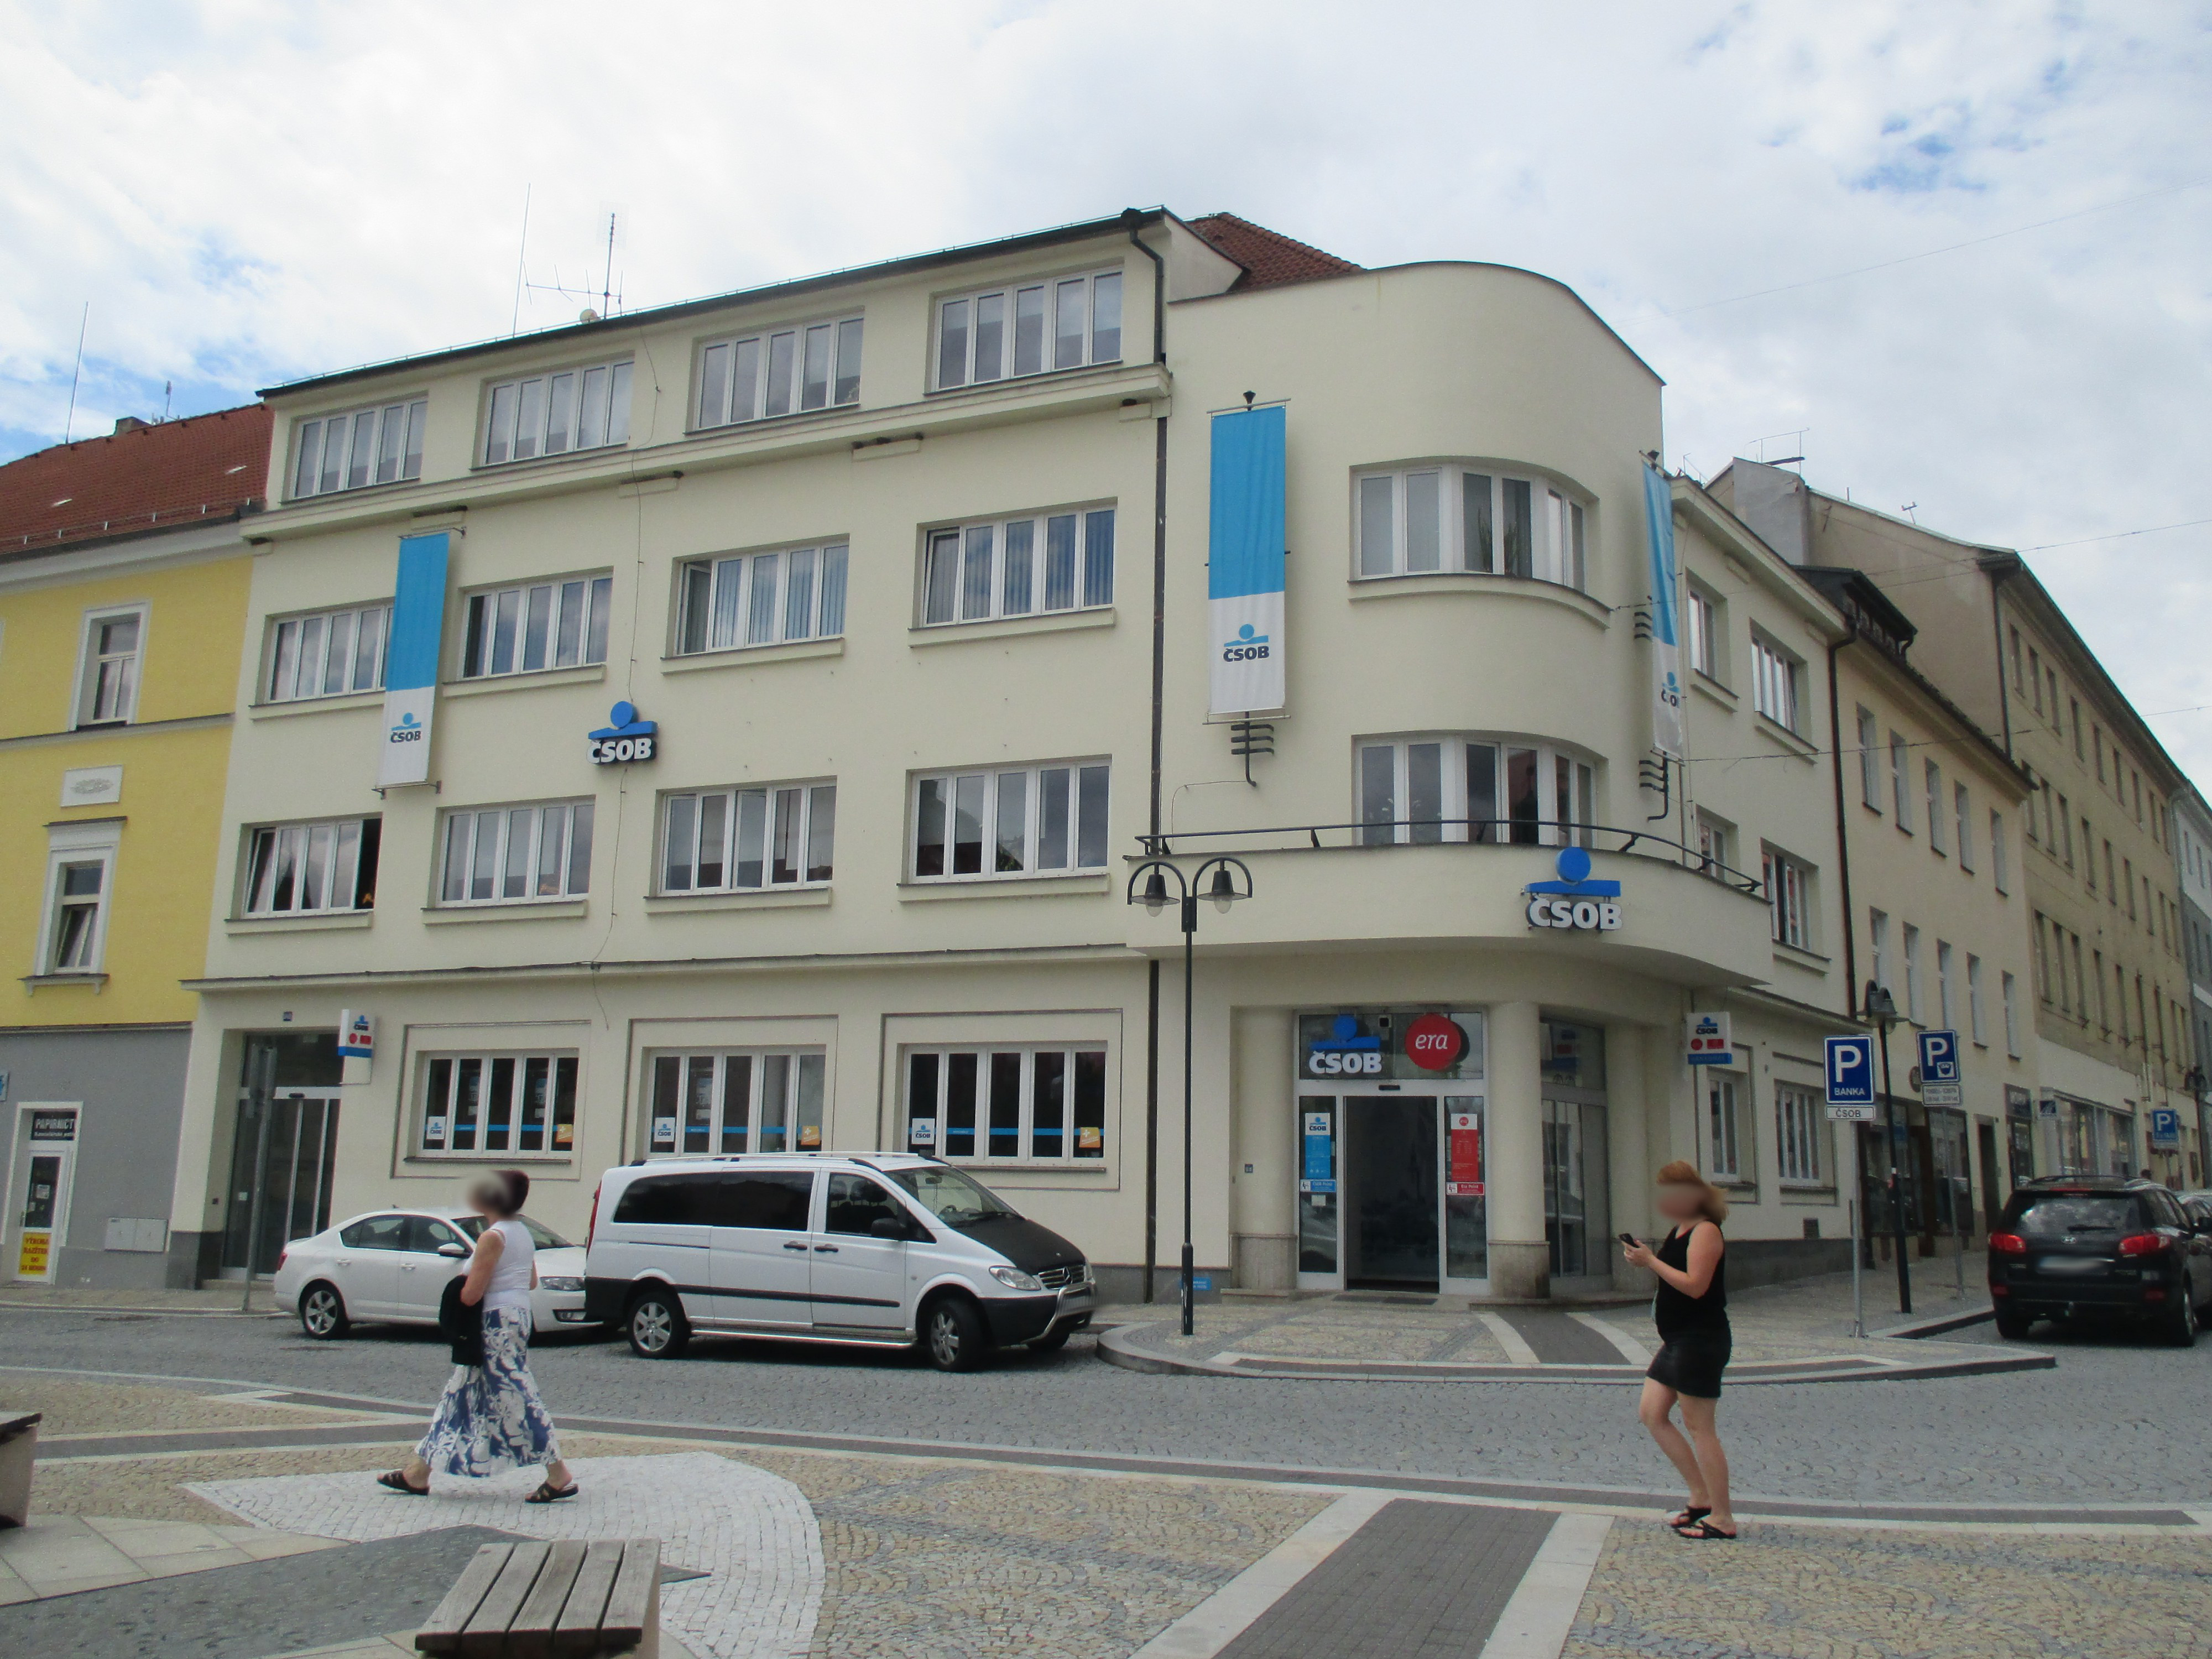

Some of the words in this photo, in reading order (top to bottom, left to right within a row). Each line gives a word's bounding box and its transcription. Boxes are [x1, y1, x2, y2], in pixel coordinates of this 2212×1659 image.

[1223, 646, 1270, 662] ČSOB
[391, 731, 421, 743] ČSOB
[586, 738, 652, 764] ČSOB
[1527, 895, 1623, 930] ČSOB
[1415, 1034, 1448, 1050] era
[1926, 1037, 1948, 1066] P
[1309, 1051, 1382, 1073] ČSOB
[1834, 1045, 1862, 1082] P
[1835, 1108, 1861, 1118] ČSOB
[2157, 1113, 2171, 1131] P
